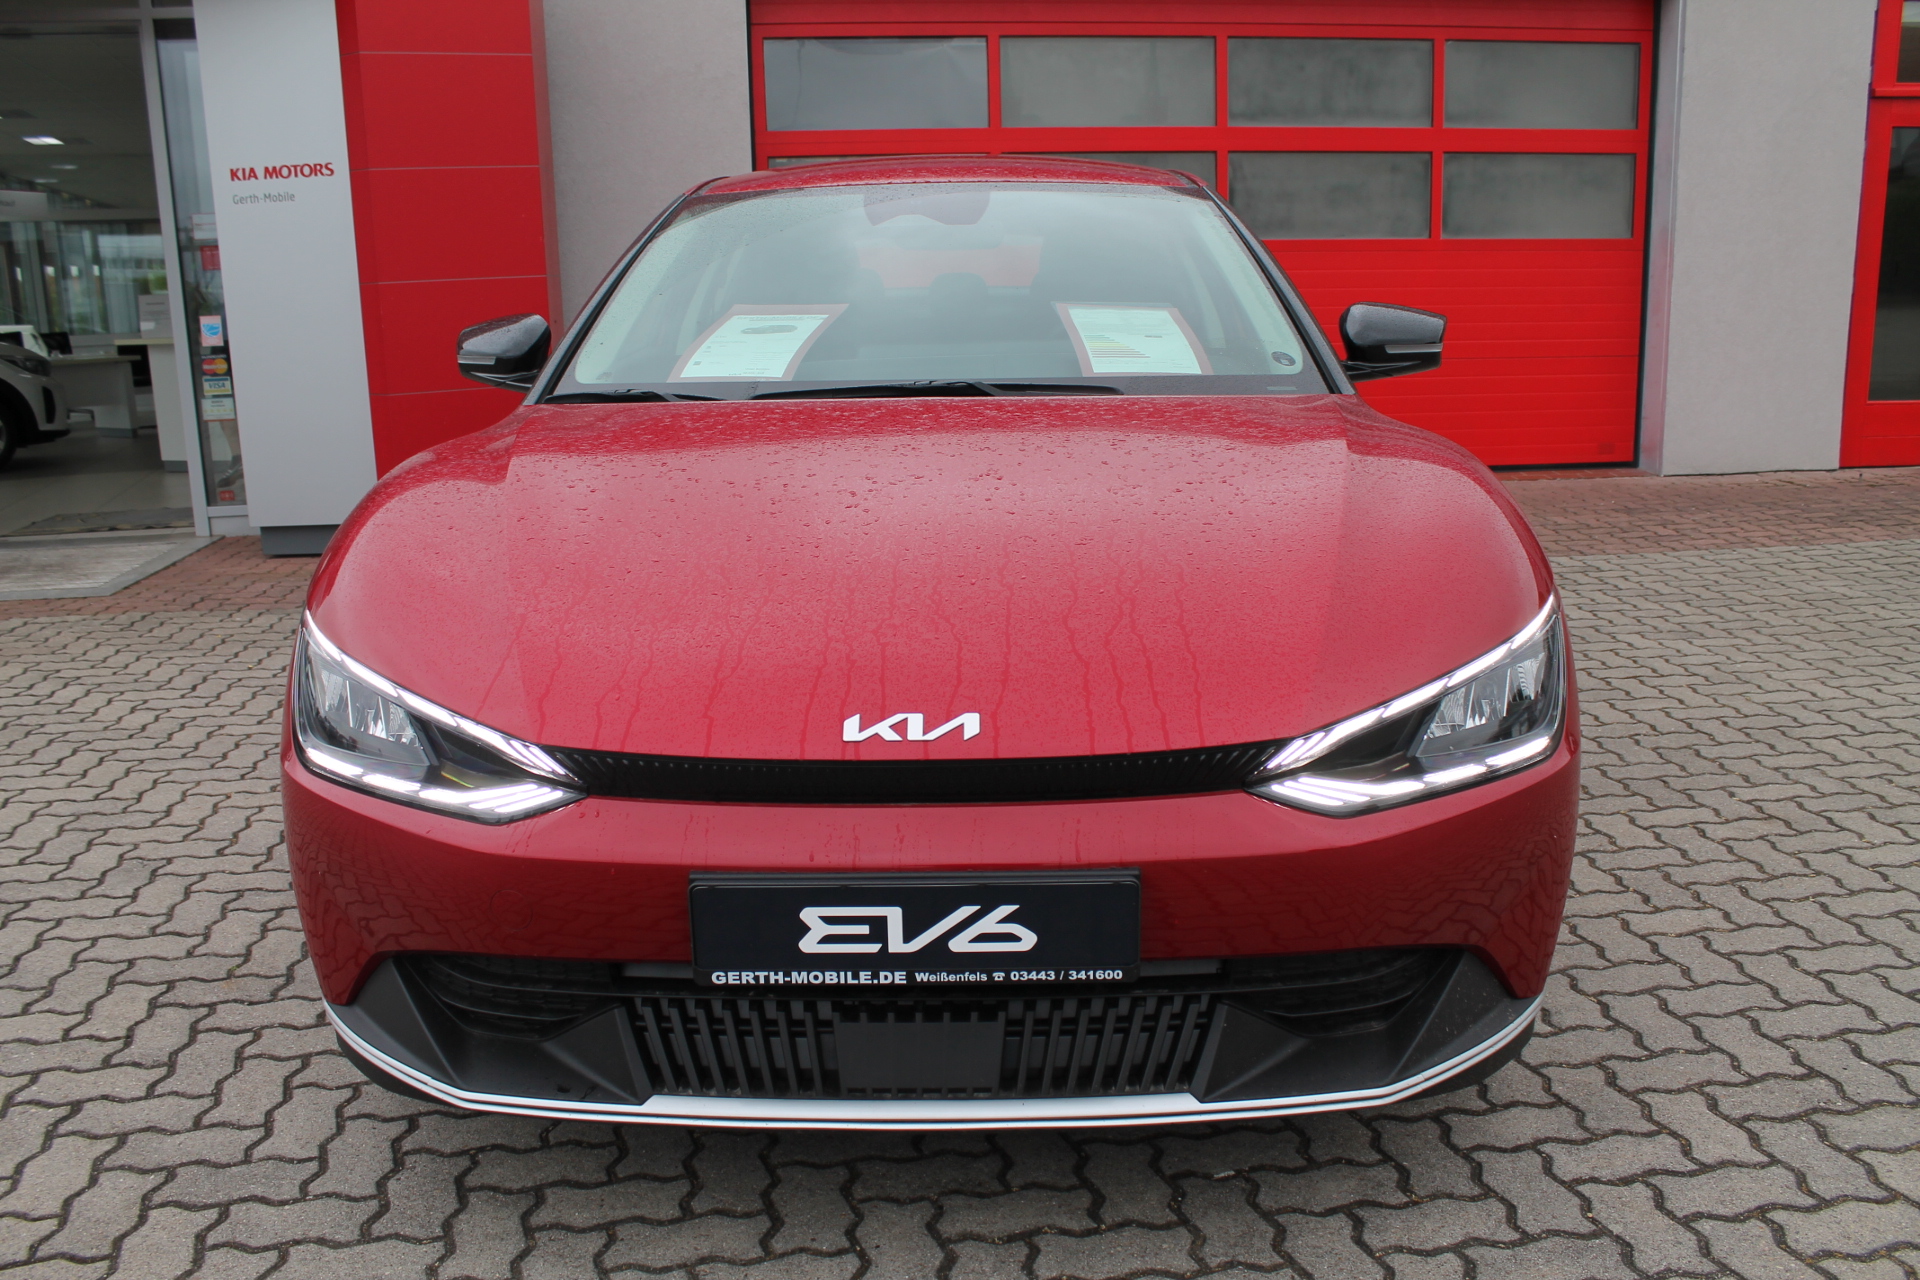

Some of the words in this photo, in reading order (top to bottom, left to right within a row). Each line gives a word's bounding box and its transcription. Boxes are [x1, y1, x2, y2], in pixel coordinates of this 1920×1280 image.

[229, 167, 258, 182] KIA
[264, 162, 335, 180] MOTORS
[232, 192, 296, 205] Gerth-Mobile
[798, 905, 1038, 953] EV6
[711, 971, 907, 985] GERTH-MOBILE.DE
[914, 971, 988, 983] Weißenfels
[1010, 970, 1056, 981] 03443
[1068, 970, 1124, 981] 341600
